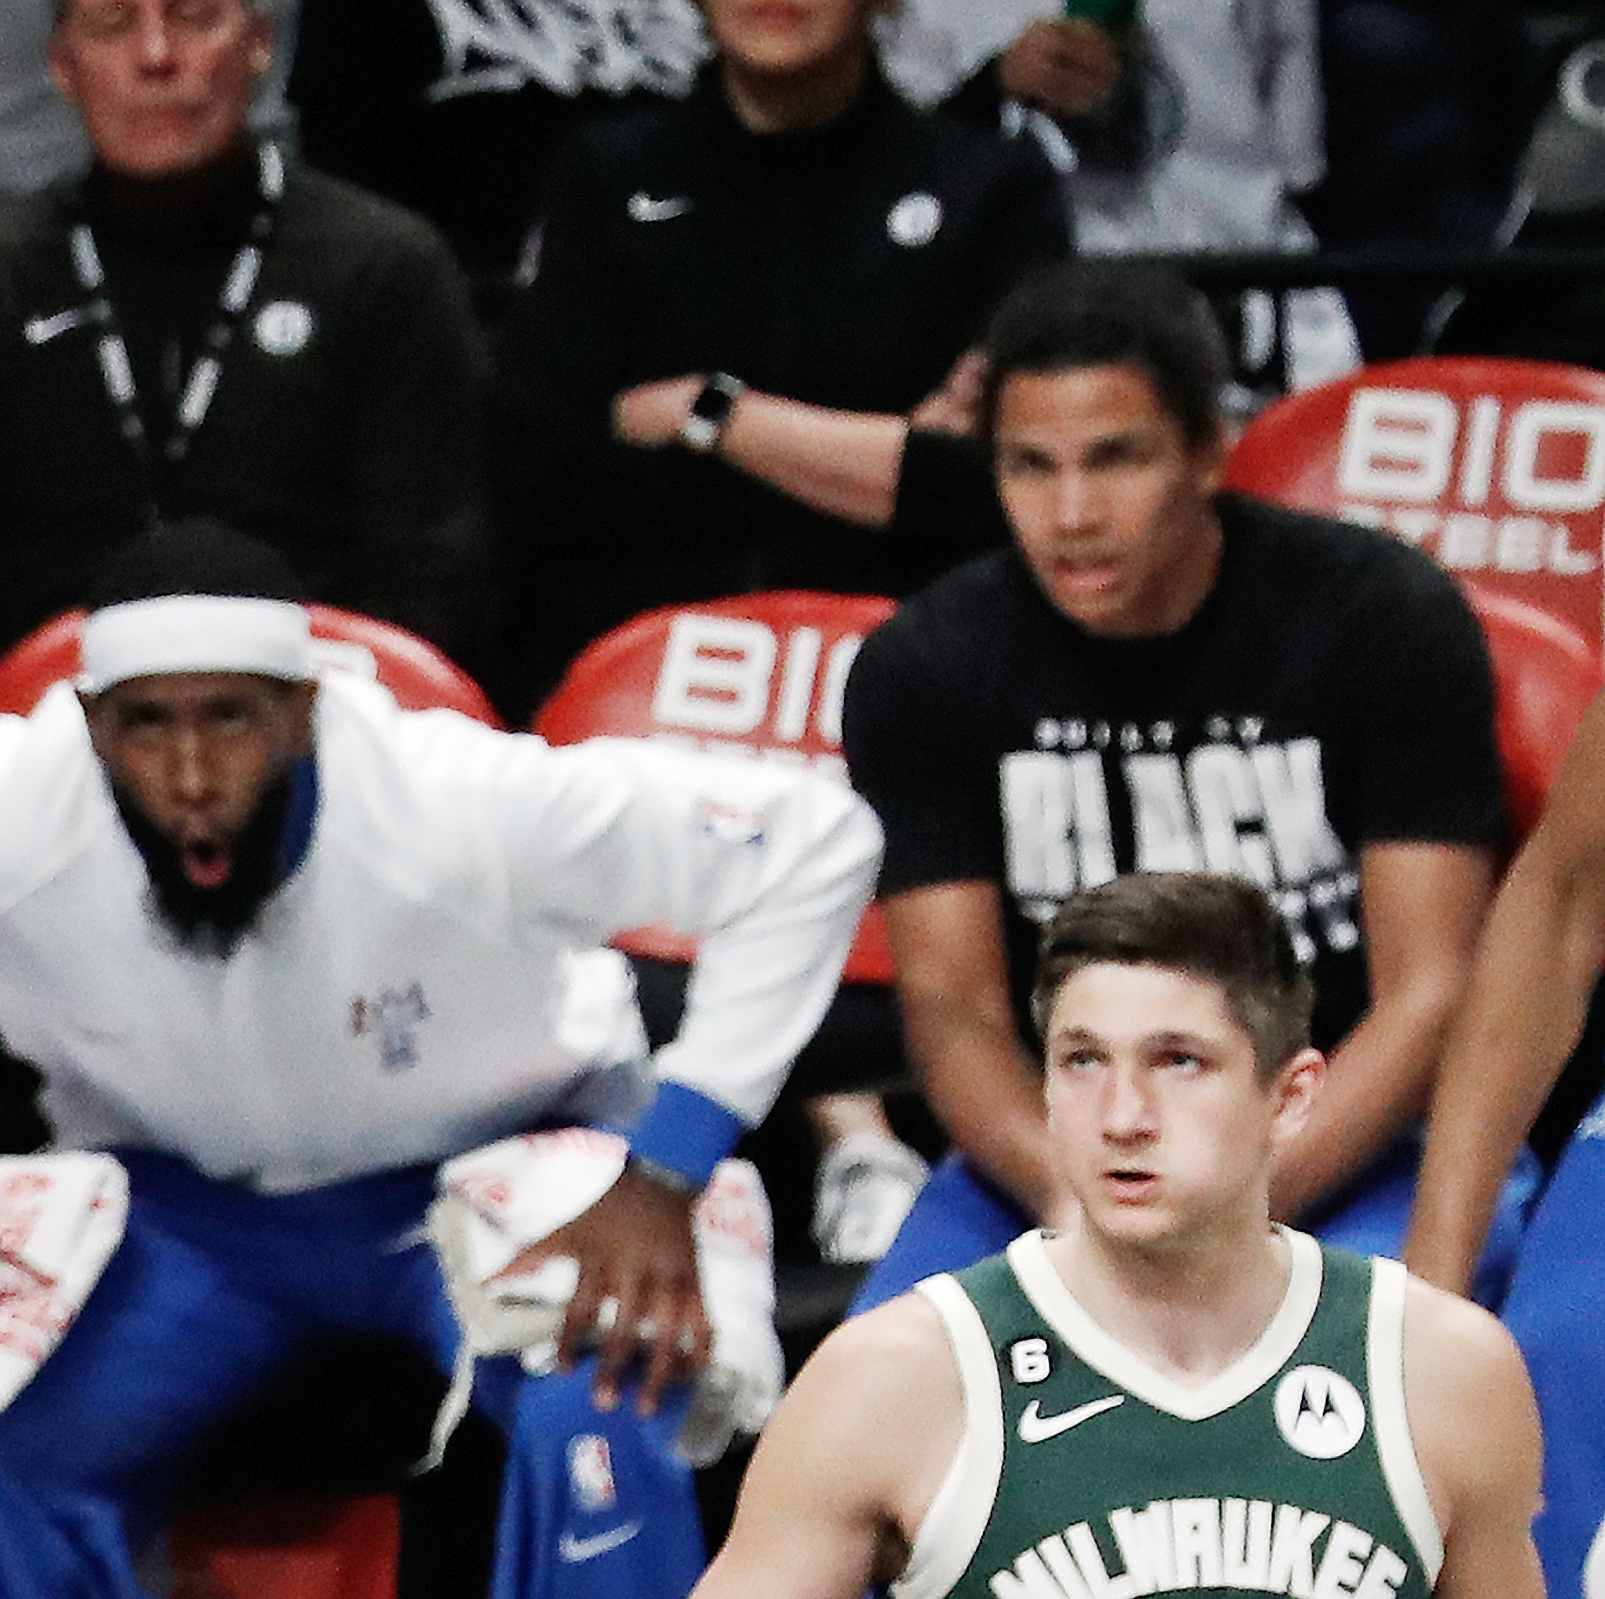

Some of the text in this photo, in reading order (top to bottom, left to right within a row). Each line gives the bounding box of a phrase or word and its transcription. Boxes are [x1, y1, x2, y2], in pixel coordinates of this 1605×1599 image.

[1340, 388, 1605, 512] BIO
[1338, 504, 1598, 574] TEEL
[1013, 1338, 1050, 1383] 6
